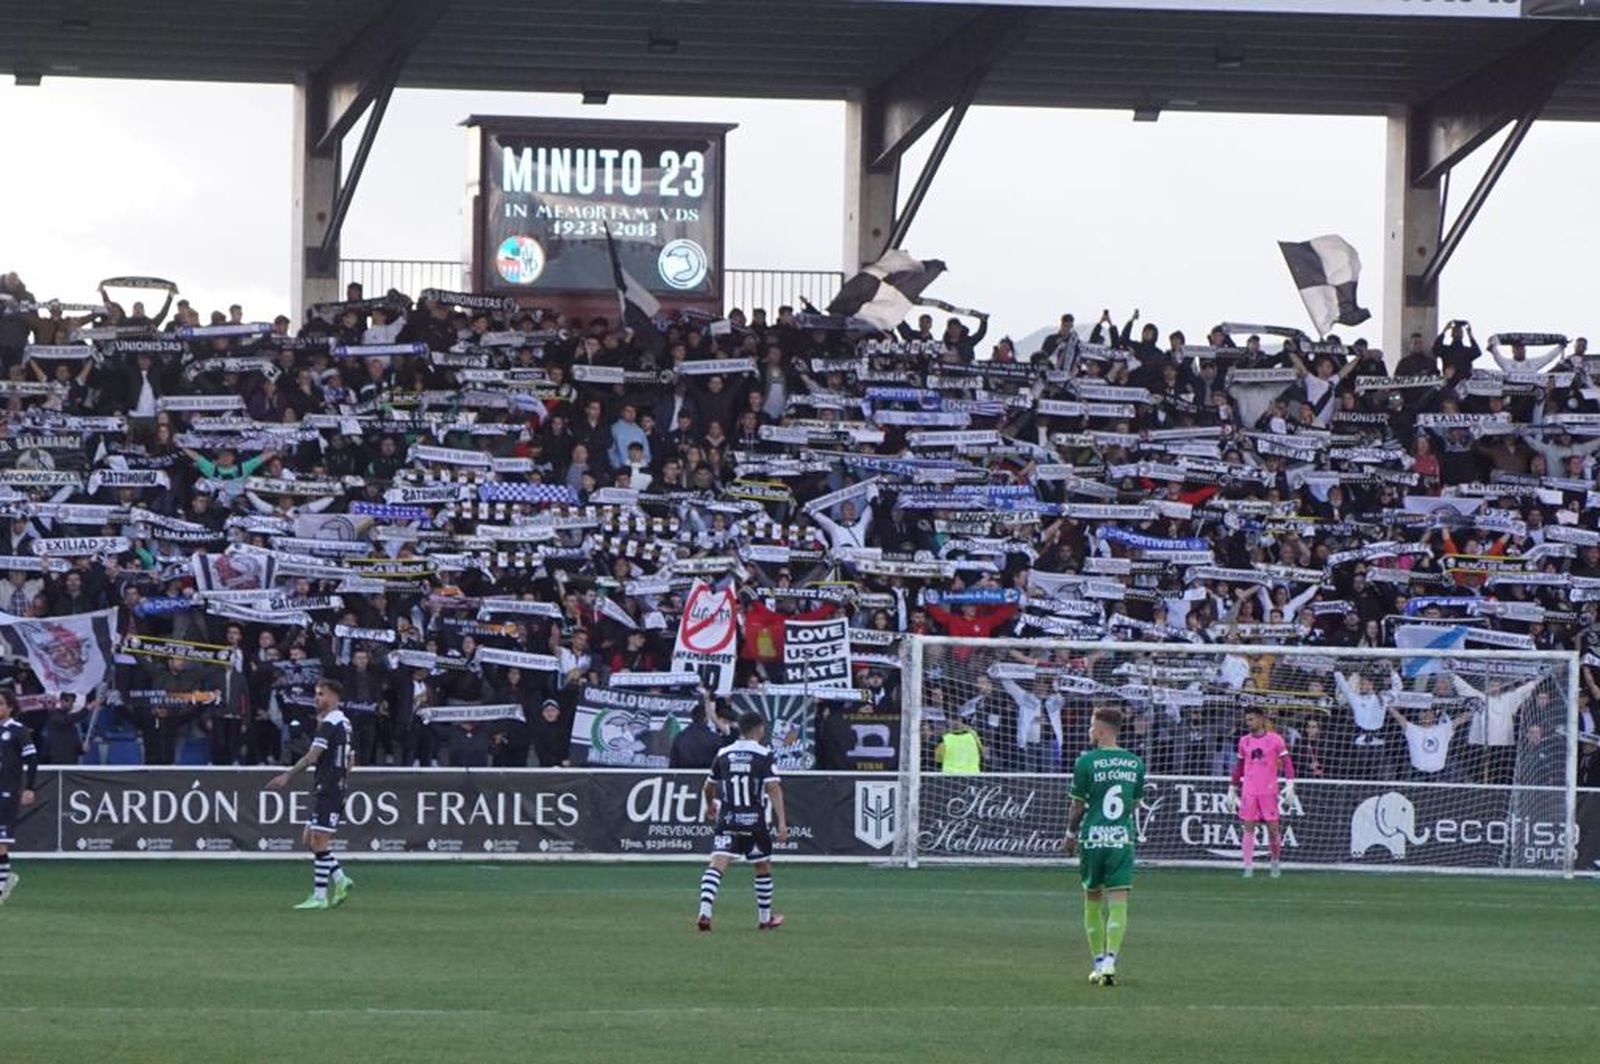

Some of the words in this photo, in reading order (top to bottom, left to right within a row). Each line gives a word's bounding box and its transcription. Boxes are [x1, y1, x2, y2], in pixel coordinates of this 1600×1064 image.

[502, 146, 643, 195] MINUTO
[658, 150, 705, 197] 23
[504, 203, 528, 218] IN
[535, 204, 650, 220] MEMORIAM
[786, 624, 844, 643] LOVE
[786, 643, 844, 660] USCF
[786, 662, 845, 682] HATE
[584, 686, 637, 707] ORGULLO
[1092, 757, 1138, 770] PELICANO
[730, 774, 751, 807] 11
[69, 778, 238, 825] SARDÓN
[259, 790, 312, 825] DE
[339, 790, 400, 826] OS
[417, 791, 579, 827] FRAILES
[946, 785, 1035, 819] Hotel
[1102, 784, 1124, 821] 6
